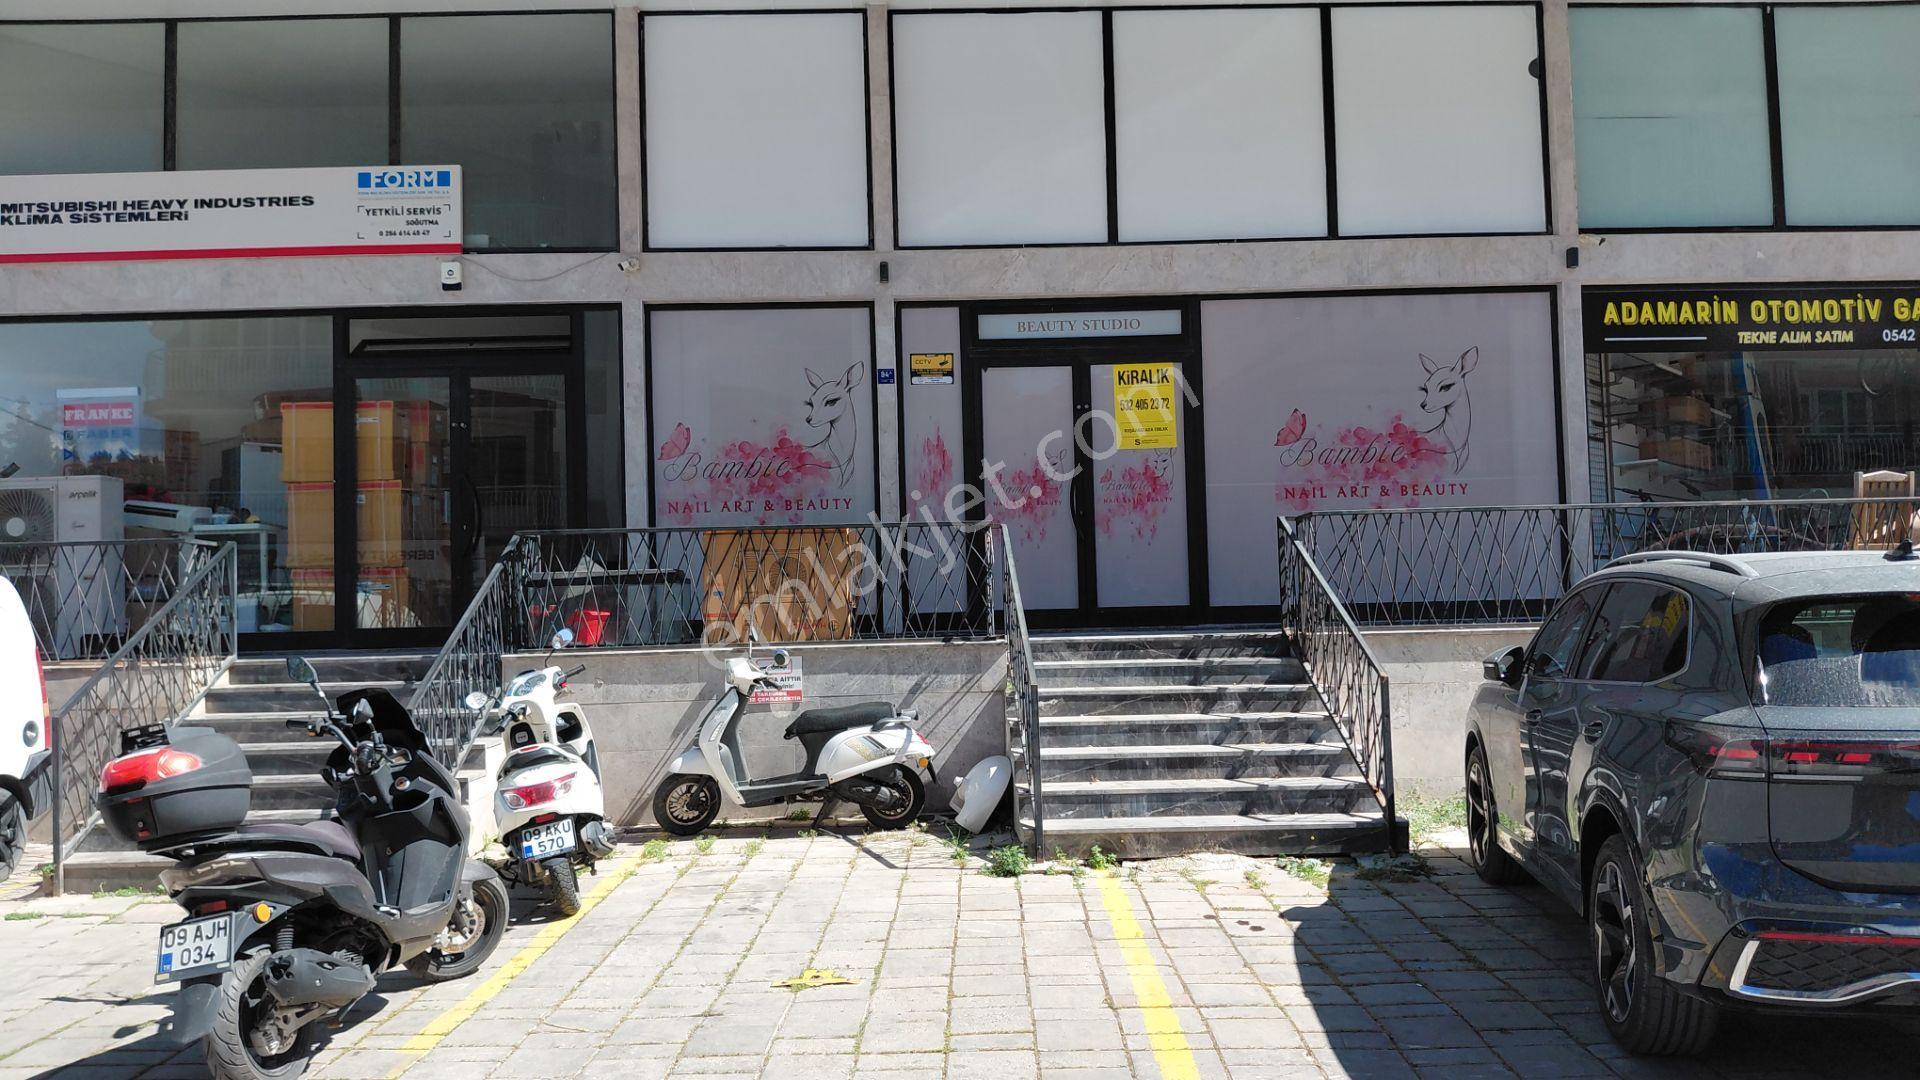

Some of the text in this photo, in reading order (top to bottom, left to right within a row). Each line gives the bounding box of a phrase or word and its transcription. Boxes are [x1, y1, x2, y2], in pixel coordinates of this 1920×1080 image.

[371, 170, 438, 188] FORM
[0, 195, 315, 213] MITSUBISHI HEAVY INDUSTRIES
[406, 205, 442, 216] SERVİS
[1603, 295, 1739, 325] ADAMARİN
[1750, 293, 1882, 324] OTOMOTİV
[1017, 318, 1141, 333] BEAUTY STUDIO
[1738, 329, 1916, 344] TEKNE ALIM SATIM 0542
[1135, 398, 1149, 411] 405
[1160, 397, 1170, 410] 72
[64, 408, 133, 421] FRANKE
[1279, 434, 1408, 467] Bambie
[663, 447, 792, 482] Bambie
[1284, 483, 1469, 499] NAIL ART & BEAUTY
[668, 498, 853, 515] NAIL ART & BEAUTY
[523, 820, 571, 842] 09 AKU
[537, 836, 565, 853] 570
[165, 919, 228, 948] 09 AJH
[180, 943, 216, 966] 034
